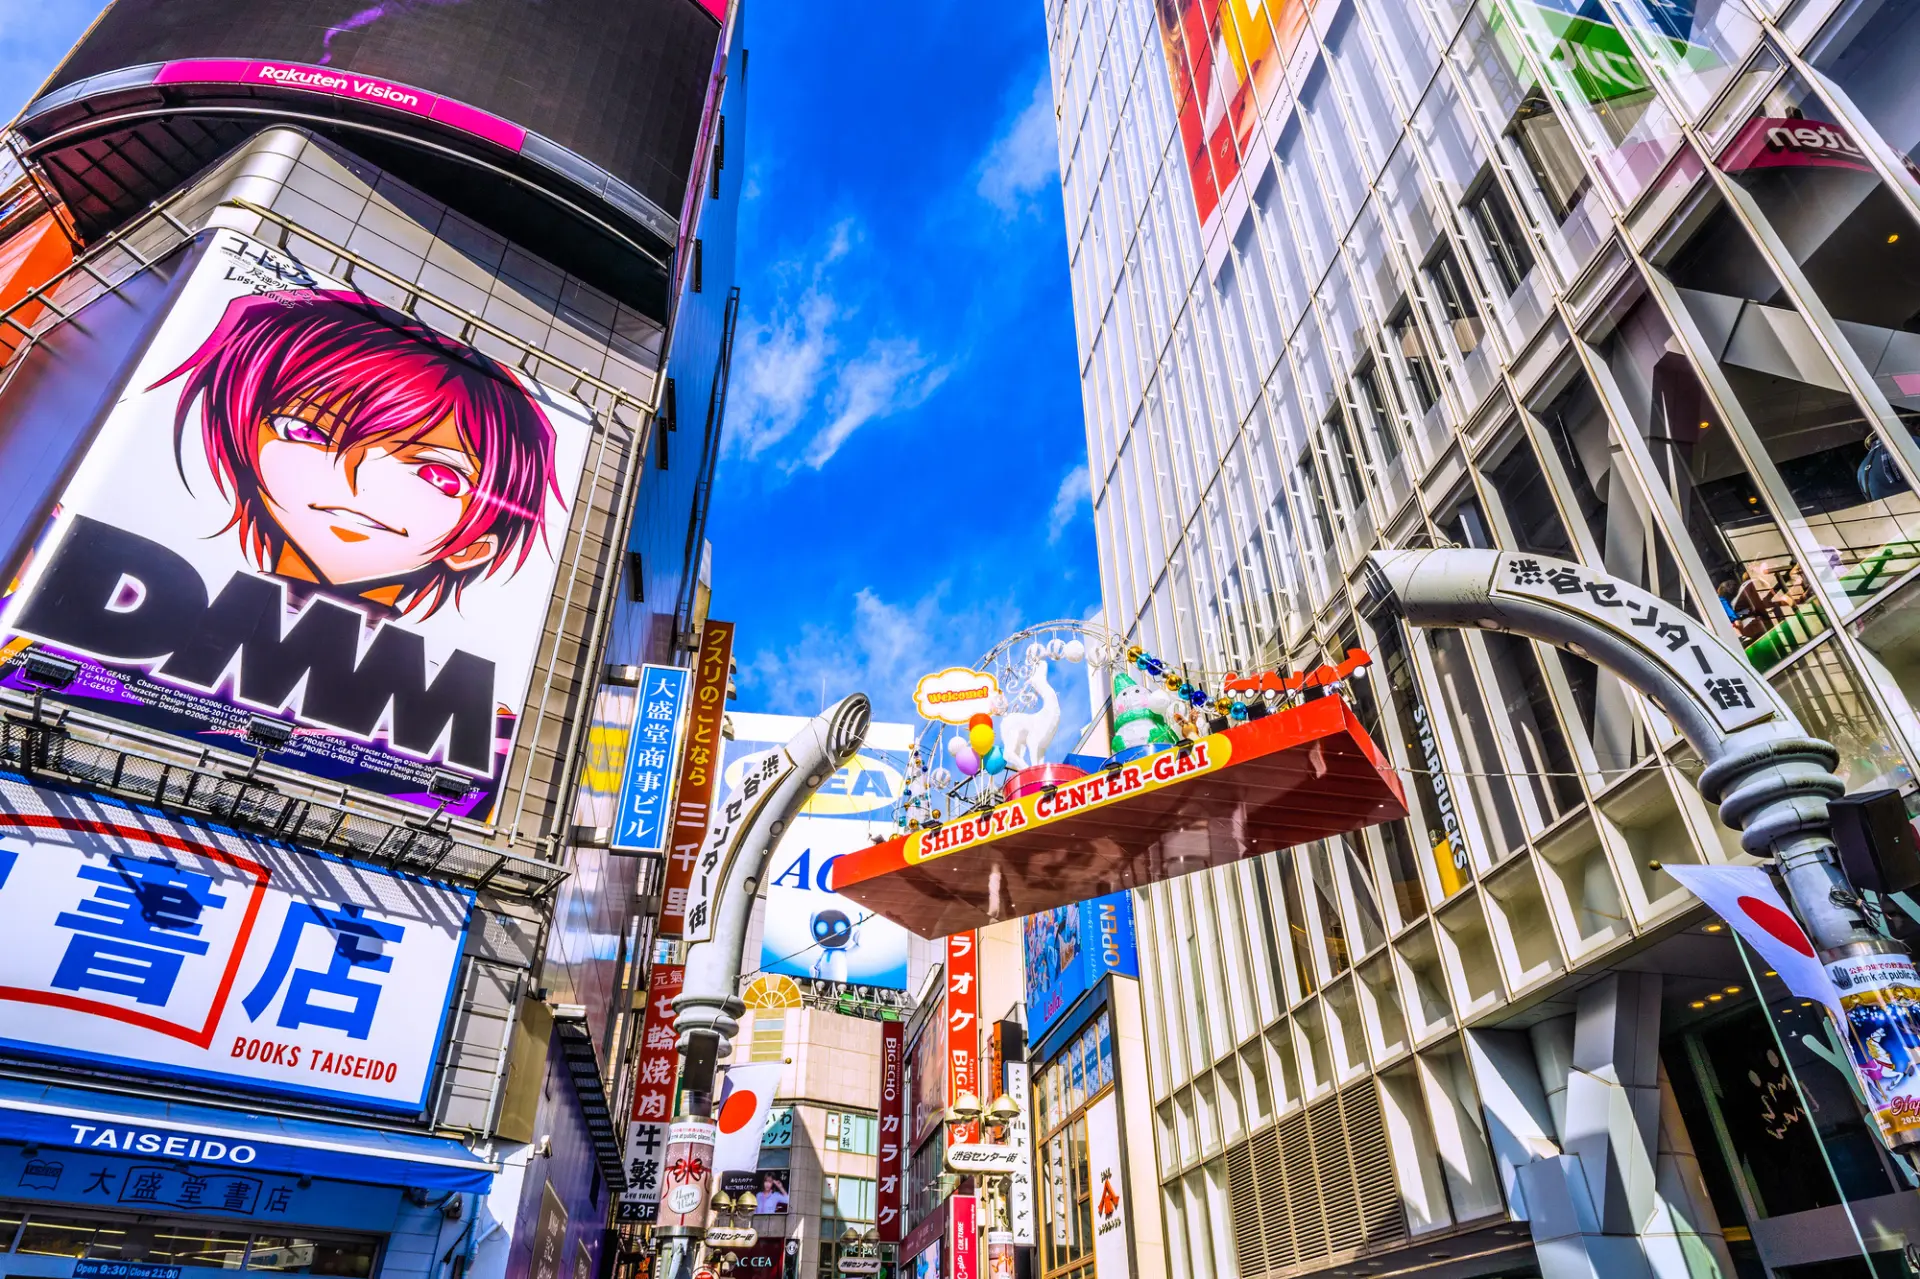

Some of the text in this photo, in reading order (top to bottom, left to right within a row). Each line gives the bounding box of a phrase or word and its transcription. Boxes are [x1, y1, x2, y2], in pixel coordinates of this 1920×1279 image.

[259, 66, 418, 107] Rakuten Vision
[1275, 51, 1309, 122] CHANL.COM
[251, 285, 295, 309] Stories
[11, 513, 496, 775] DMM
[1508, 558, 1755, 710] 渋谷センター街
[83, 680, 115, 694] L-GEASS
[121, 690, 156, 707] Character
[157, 701, 184, 716] Design
[85, 672, 117, 687] G-AKITO
[123, 683, 159, 700] Character
[159, 692, 186, 708] Design
[229, 712, 249, 725] CLAM
[106, 669, 131, 683] GEASS
[137, 678, 173, 695] Character
[172, 687, 199, 703] Design
[928, 685, 989, 707] Welcome!
[326, 734, 347, 747] GEASS
[351, 743, 382, 758] Character
[382, 751, 403, 764] Design
[331, 745, 358, 758] L-GEASS
[363, 754, 394, 768] Character
[394, 762, 414, 775] Design
[360, 761, 390, 775] Character
[390, 769, 411, 782] Design
[624, 678, 676, 838] 大盛堂商事ビル
[664, 629, 727, 917] クスリのことなら 三千里
[1413, 704, 1469, 870] STARBUCKS
[920, 744, 1210, 857] SHIBUYA CENTER-GAI
[688, 754, 779, 935] 渋谷センター街
[0, 851, 405, 1041] 書店
[1099, 904, 1121, 968] OPEN
[949, 936, 975, 1032] ラオケ
[1853, 973, 1878, 985] drink
[1879, 971, 1888, 981] at
[1888, 969, 1912, 982] public
[230, 1036, 398, 1083] BOOKS TAISEIDO
[637, 994, 677, 1118] 七輪焼肉
[884, 1037, 897, 1101] BIG ECHO
[952, 1050, 968, 1086] BIG
[70, 1124, 256, 1164] TAISEIDO
[842, 1114, 851, 1147] 皮フ科
[629, 1123, 661, 1190] 牛繁
[879, 1114, 899, 1225] カラオケ
[952, 1151, 1018, 1163] 渋谷センター街
[83, 1167, 294, 1214] 大盛堂書店
[957, 1221, 965, 1250] CULTURE
[76, 1263, 179, 1279] Open 9:30 Close 21:00
[751, 1257, 772, 1267] CEA
